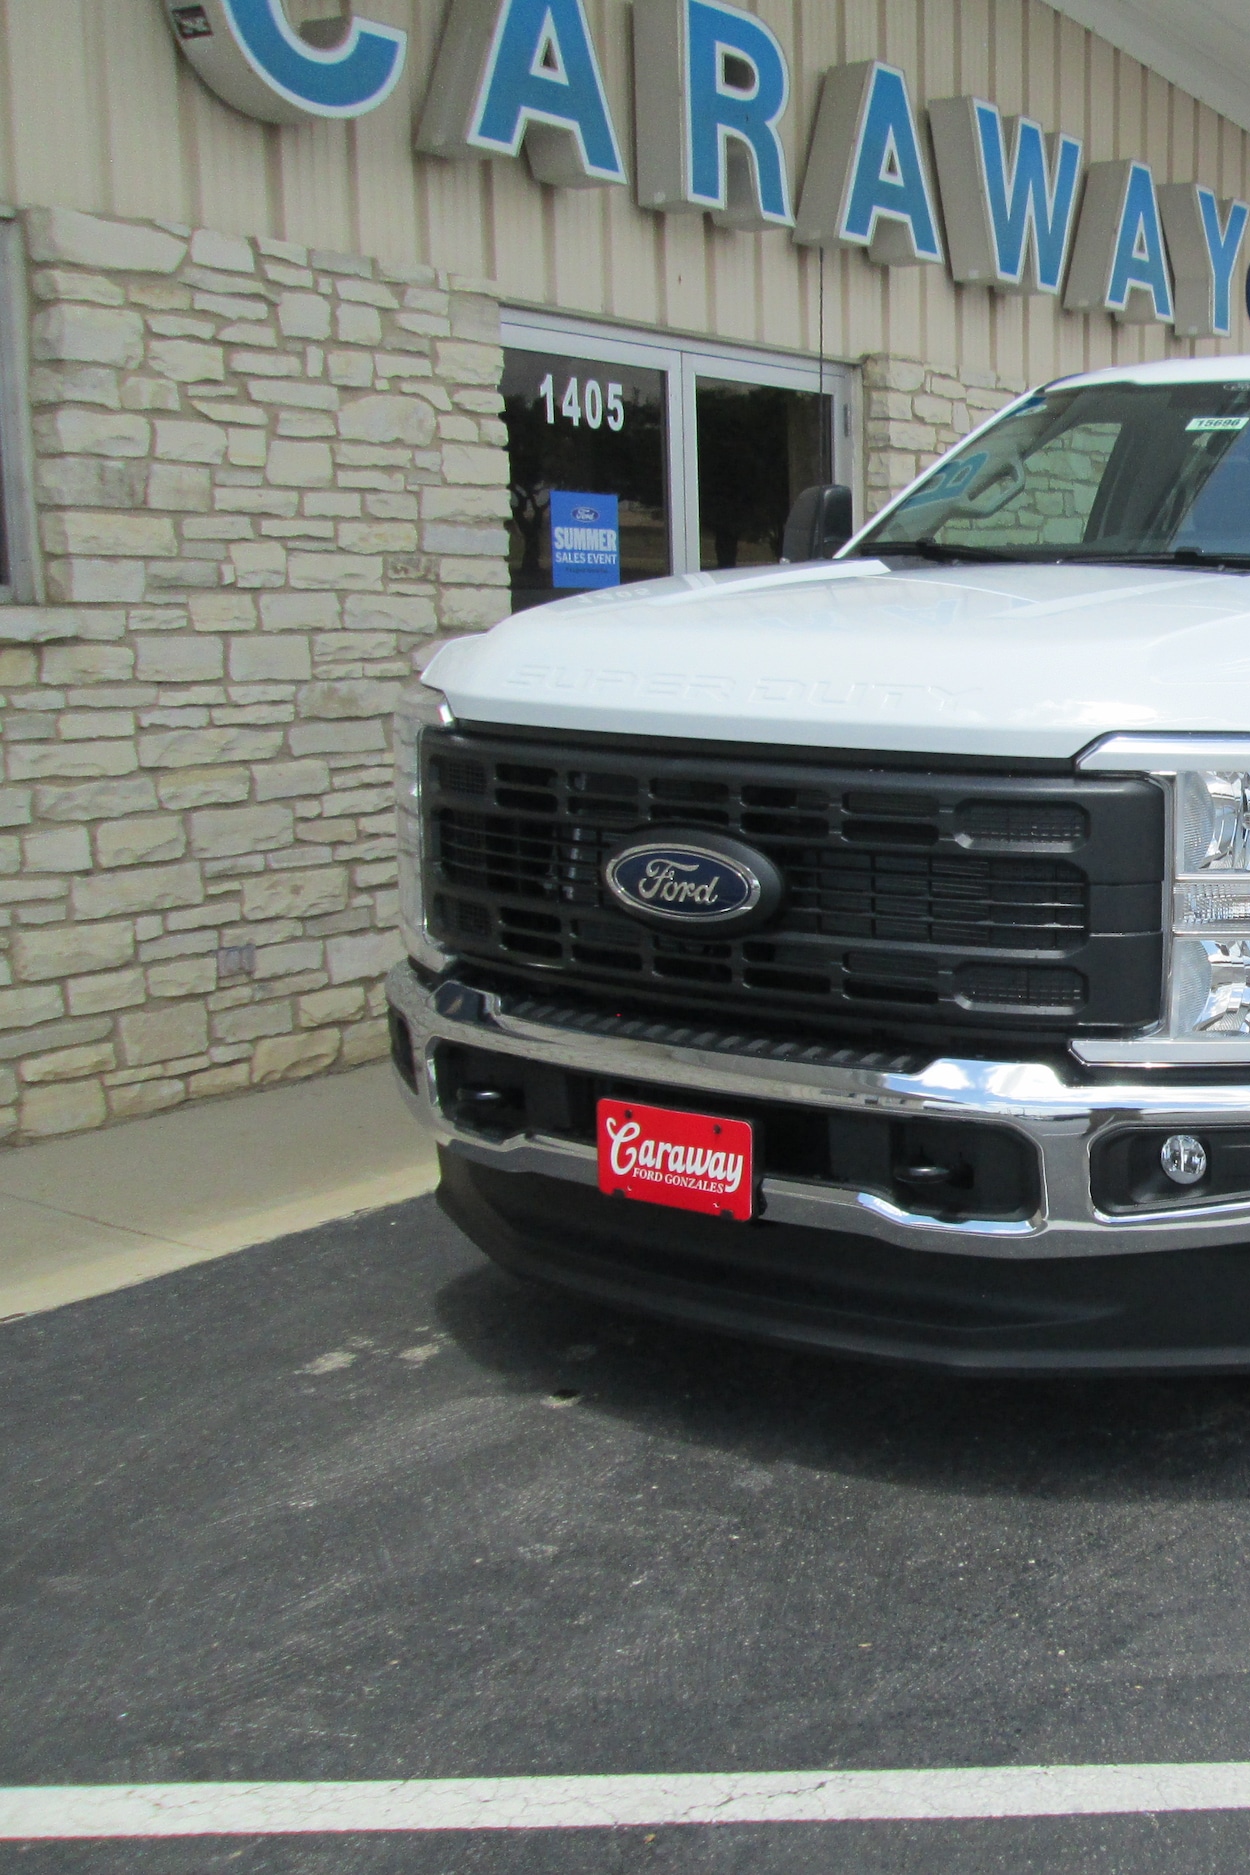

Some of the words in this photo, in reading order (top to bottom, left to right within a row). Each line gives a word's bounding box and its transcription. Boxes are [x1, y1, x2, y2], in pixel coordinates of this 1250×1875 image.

[539, 373, 625, 432] 1405
[554, 526, 617, 552] SUMMER
[555, 552, 586, 564] SALES
[587, 553, 617, 565] EVENT
[503, 663, 737, 704] SUPER
[748, 677, 984, 712] DUTY
[638, 858, 720, 906] Ford
[606, 1117, 744, 1193] Caraway
[632, 1167, 664, 1183] FORD
[664, 1174, 724, 1194] GONZALES
